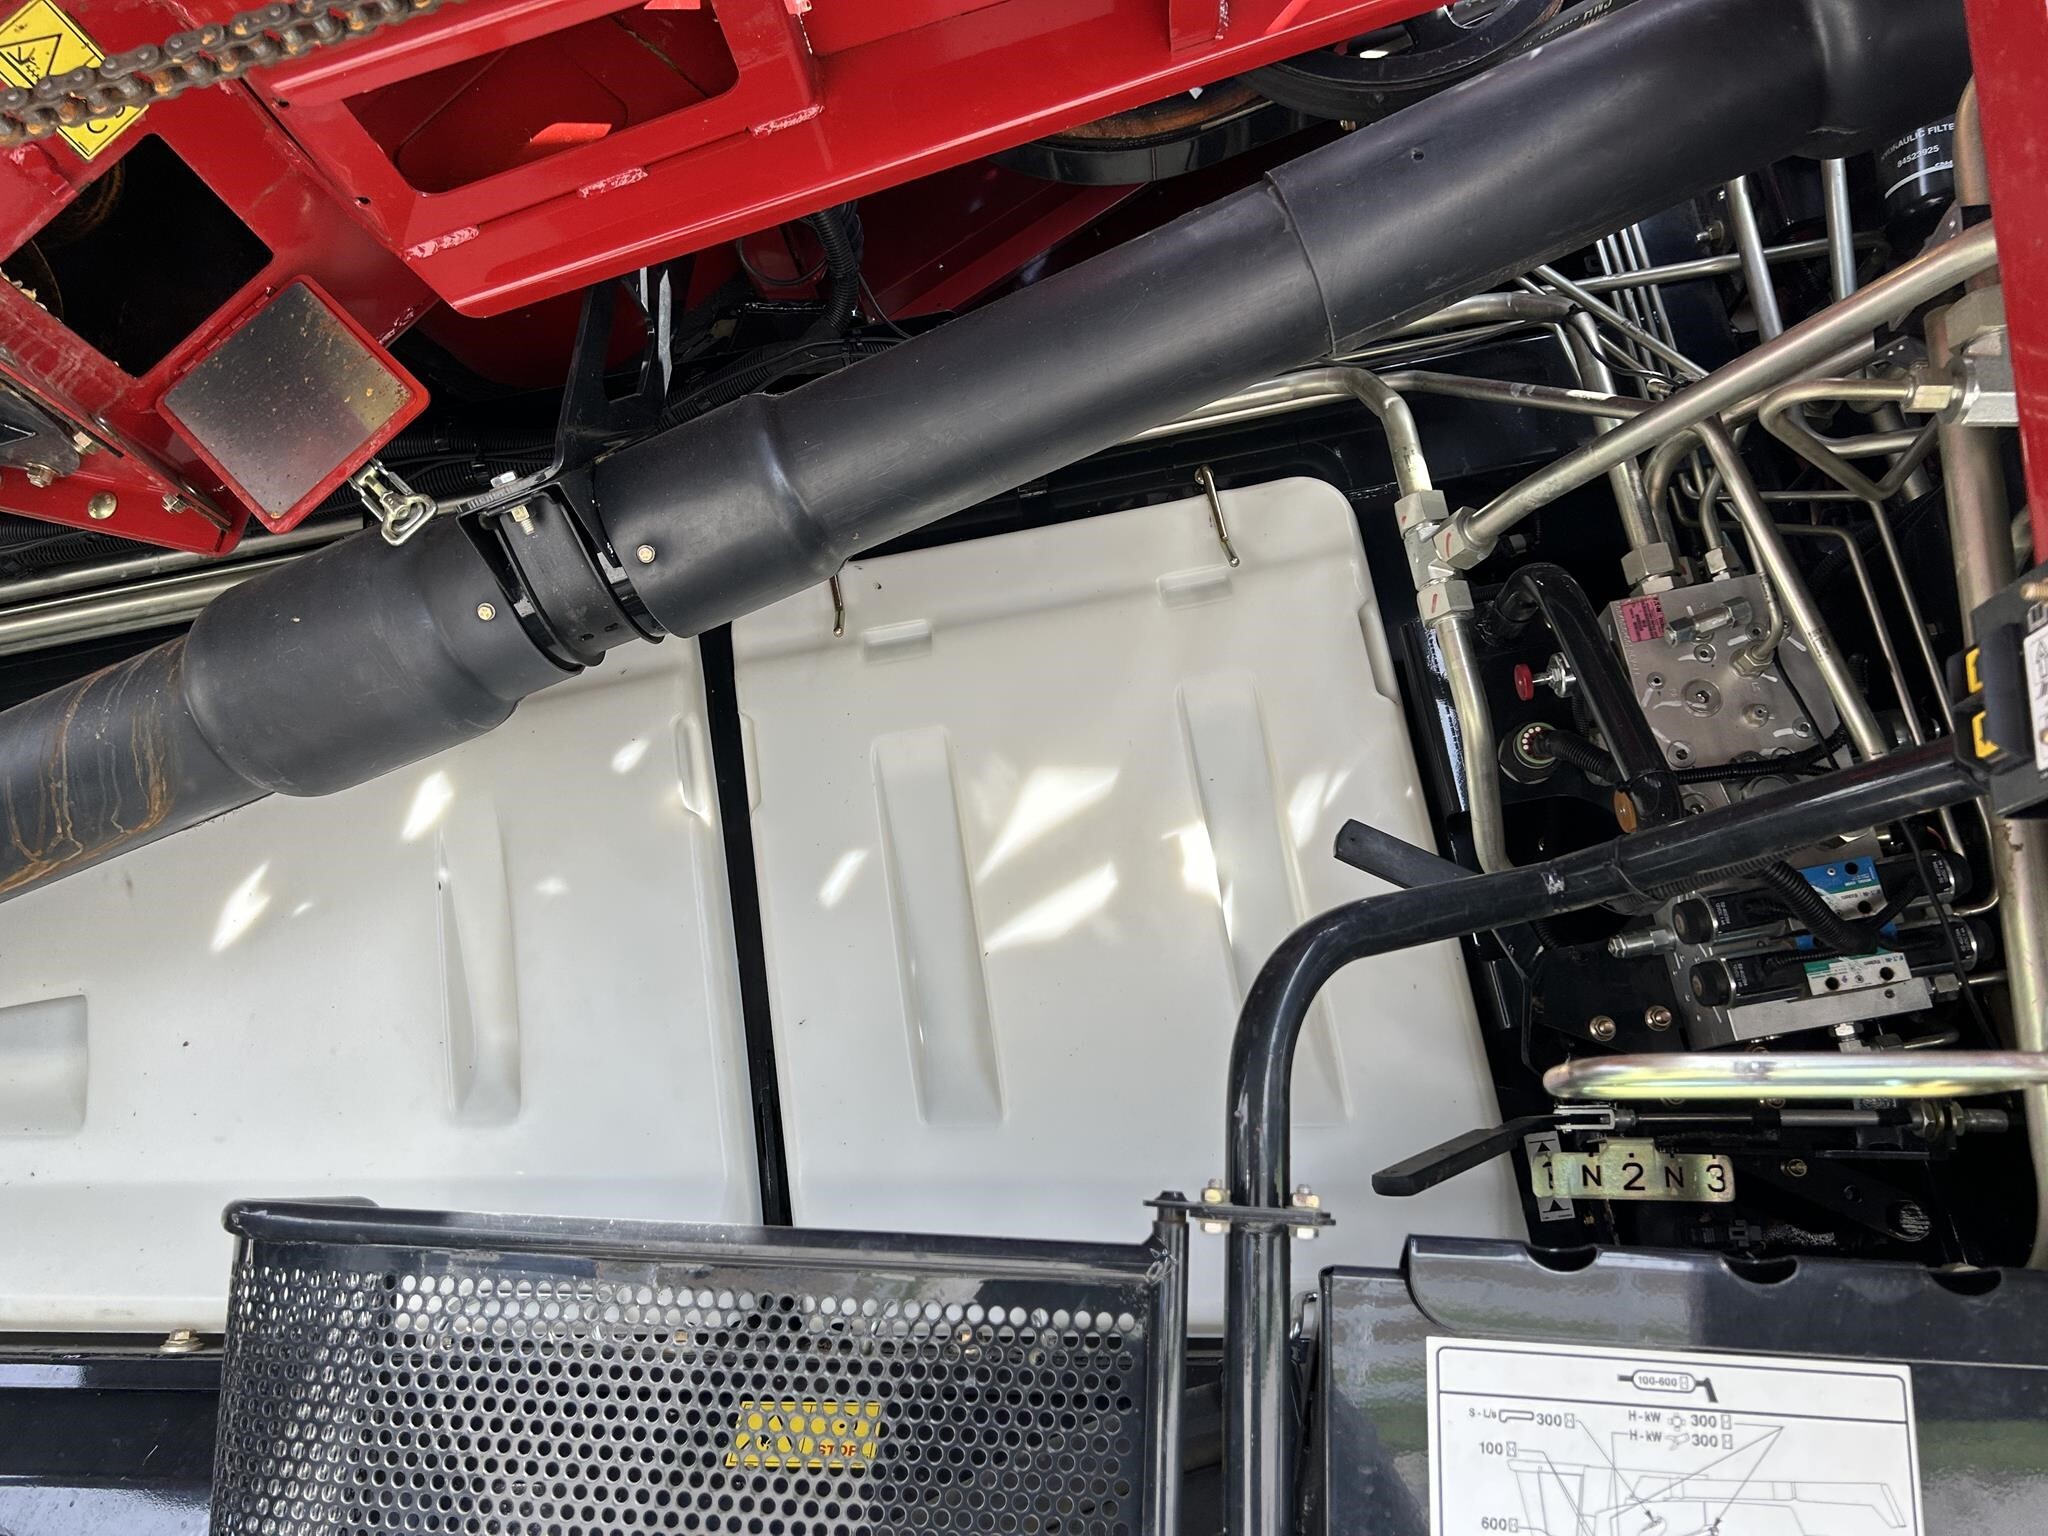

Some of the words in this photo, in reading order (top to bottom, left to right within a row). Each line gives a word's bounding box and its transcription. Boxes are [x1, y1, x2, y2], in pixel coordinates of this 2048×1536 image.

[1927, 122, 1955, 135] FILTE
[1582, 1164, 1602, 1187] N
[1622, 1162, 1646, 1191] 2
[1664, 1165, 1685, 1188] N
[1706, 1163, 1727, 1193] 3
[1638, 1375, 1678, 1388] 100-600
[1536, 1412, 1563, 1427] 300
[1690, 1414, 1718, 1428] 300
[1479, 1441, 1504, 1455] 100
[1691, 1434, 1719, 1448] 300
[1481, 1516, 1508, 1531] 600
